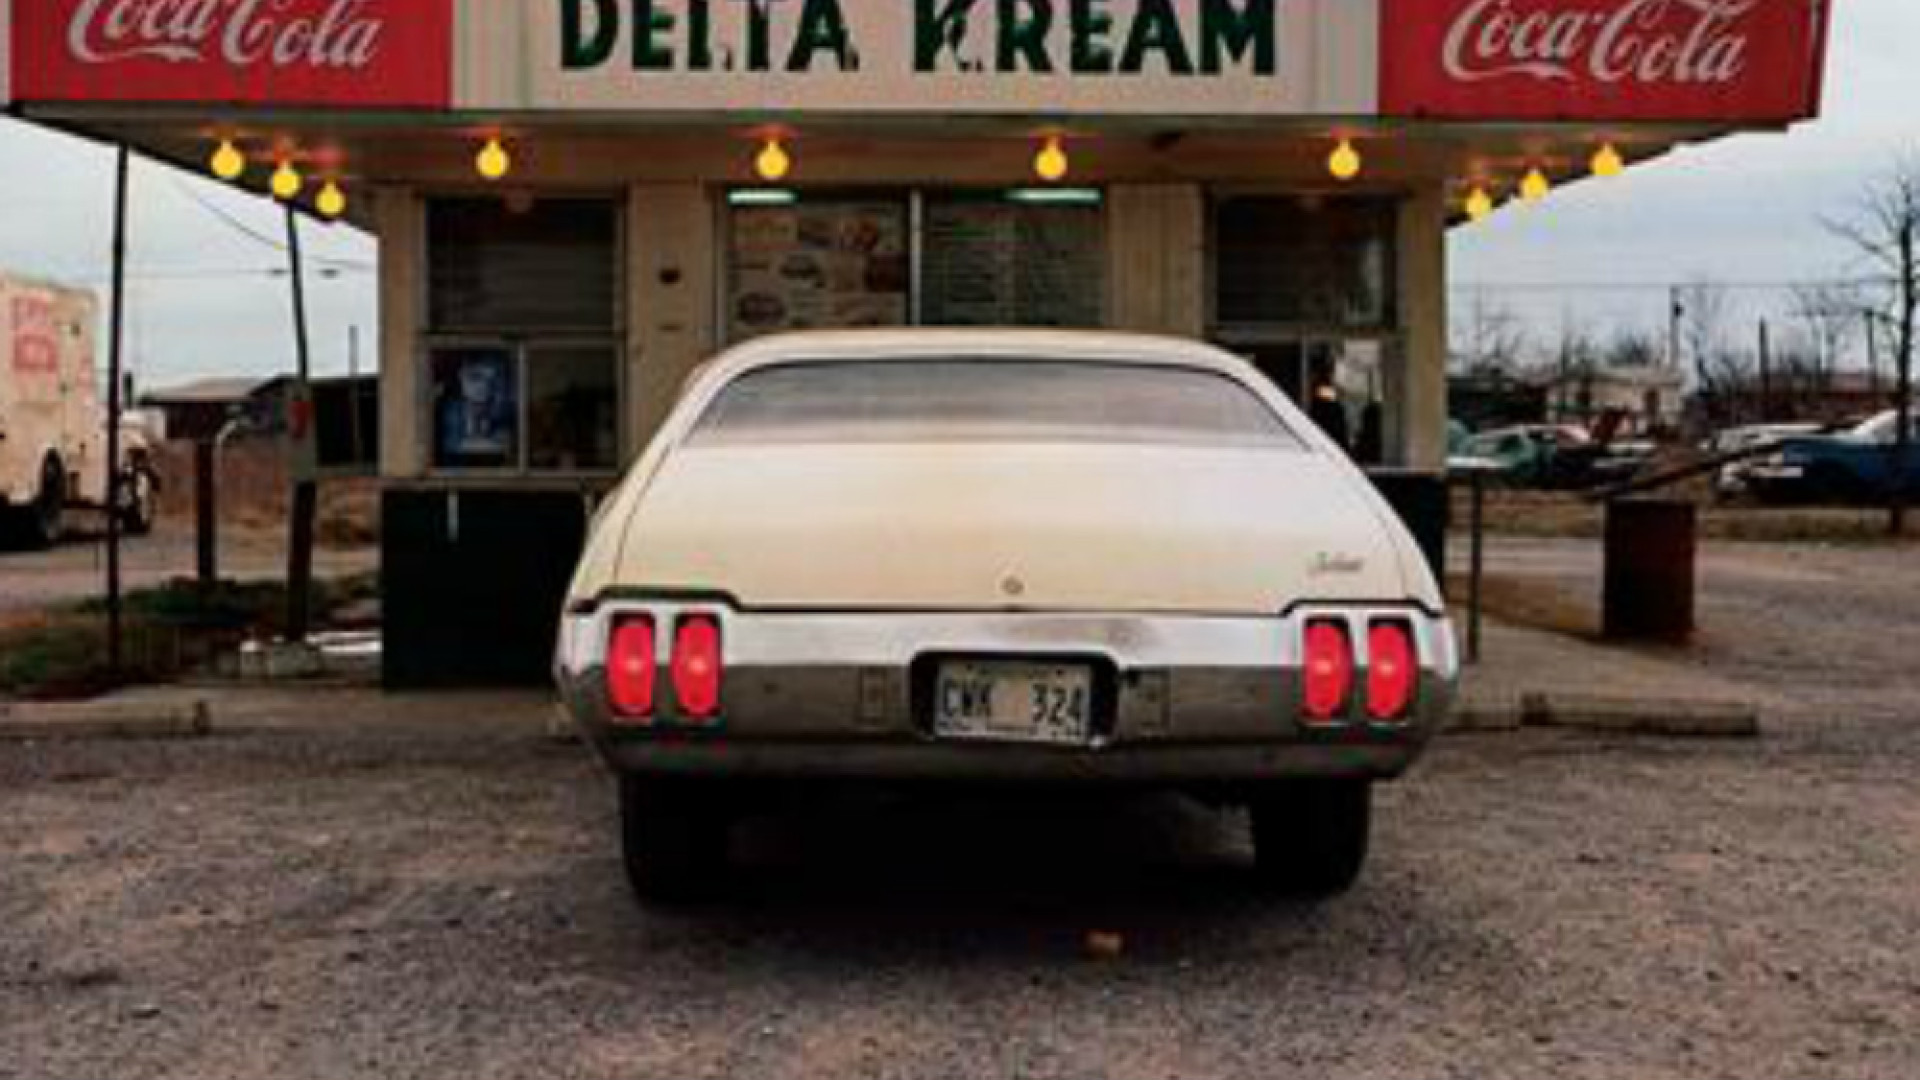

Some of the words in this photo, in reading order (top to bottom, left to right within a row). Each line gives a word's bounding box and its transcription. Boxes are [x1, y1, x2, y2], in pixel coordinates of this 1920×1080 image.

[560, 0, 859, 70] DELTA
[914, 0, 1276, 76] KREAM
[1031, 682, 1084, 727] 324
